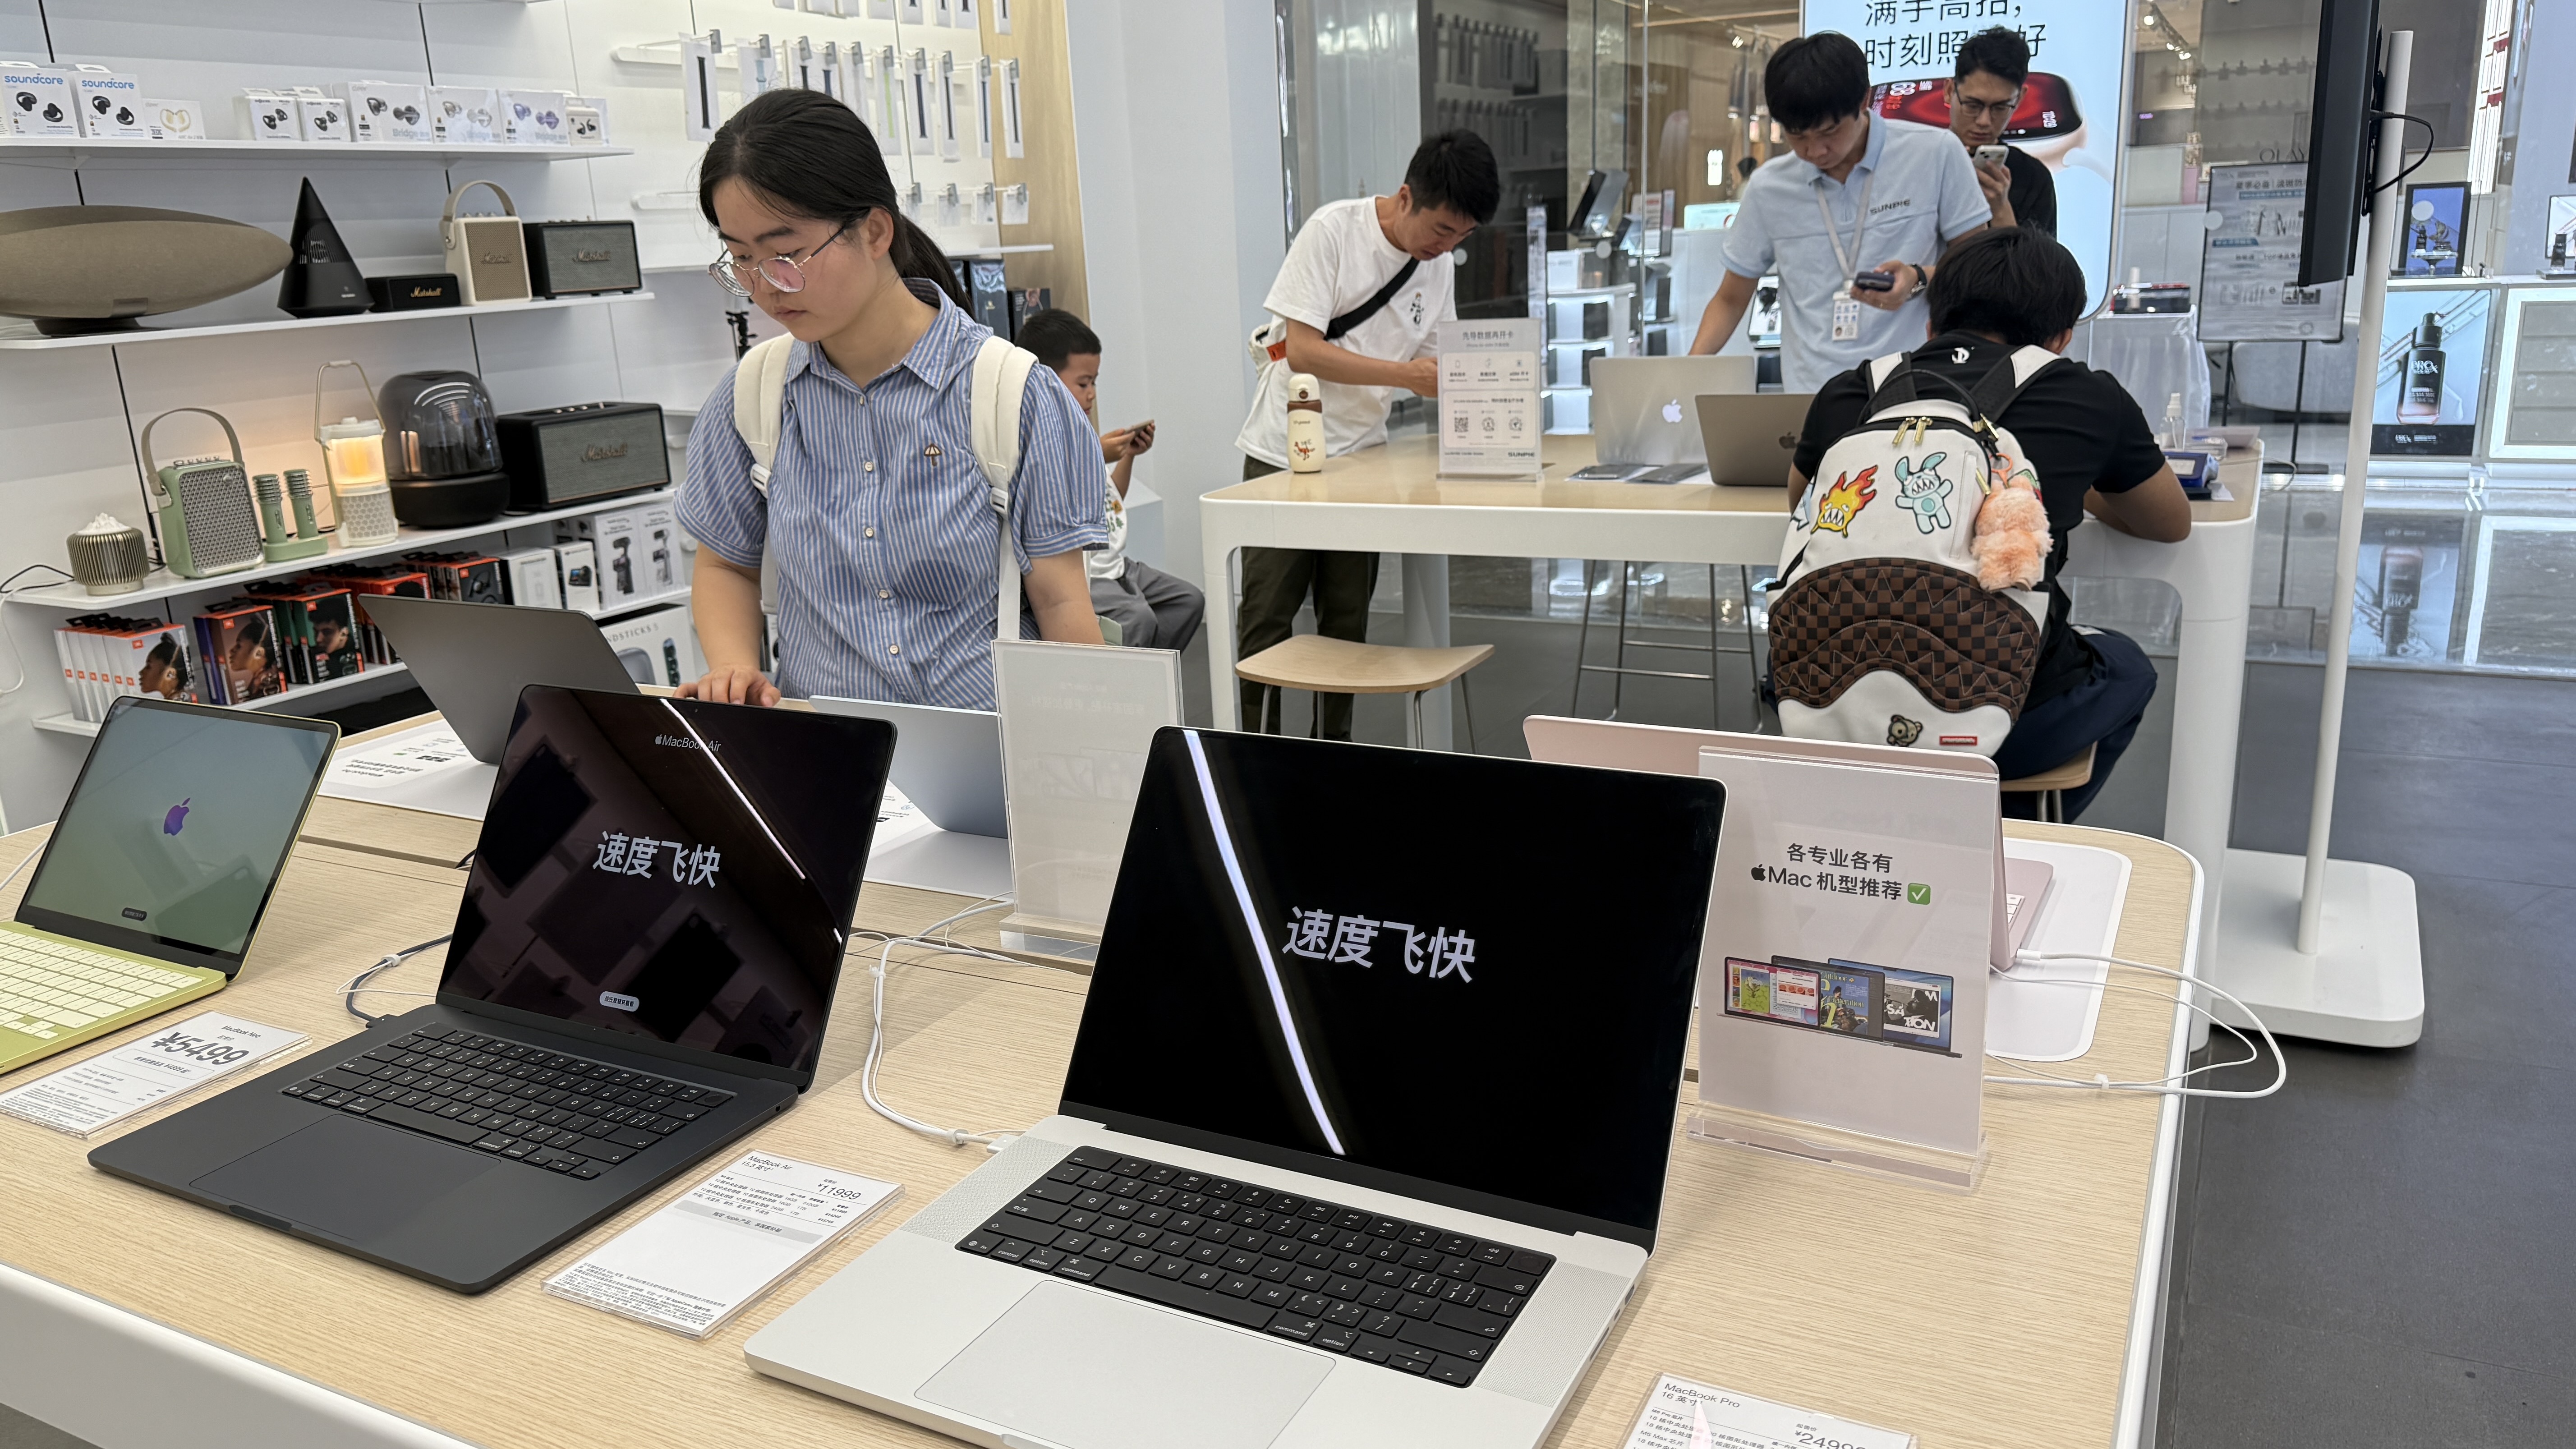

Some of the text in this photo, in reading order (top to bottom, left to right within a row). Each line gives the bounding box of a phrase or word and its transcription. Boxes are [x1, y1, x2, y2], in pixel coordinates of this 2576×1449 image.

[1865, 24, 2046, 69] 时刻照好
[5, 74, 63, 85] soundcore
[82, 78, 134, 89] soundcore
[573, 249, 612, 263] Marshall
[410, 286, 442, 297] Marshall
[662, 735, 721, 751] MacBoo Air
[593, 831, 721, 888] 速度飞快
[1787, 843, 1893, 873] 各专业各有
[1768, 866, 1902, 900] Mac 机型推荐
[1282, 906, 1476, 984] 速度飞快
[151, 1032, 249, 1065] ¥5499
[748, 1156, 782, 1168] MacBook
[818, 1183, 861, 1200] ¥11999
[1665, 1383, 1740, 1408] MacBook Pro
[1796, 1423, 1817, 1432] 起售价
[1718, 1433, 1764, 1449] 核图形处理器
